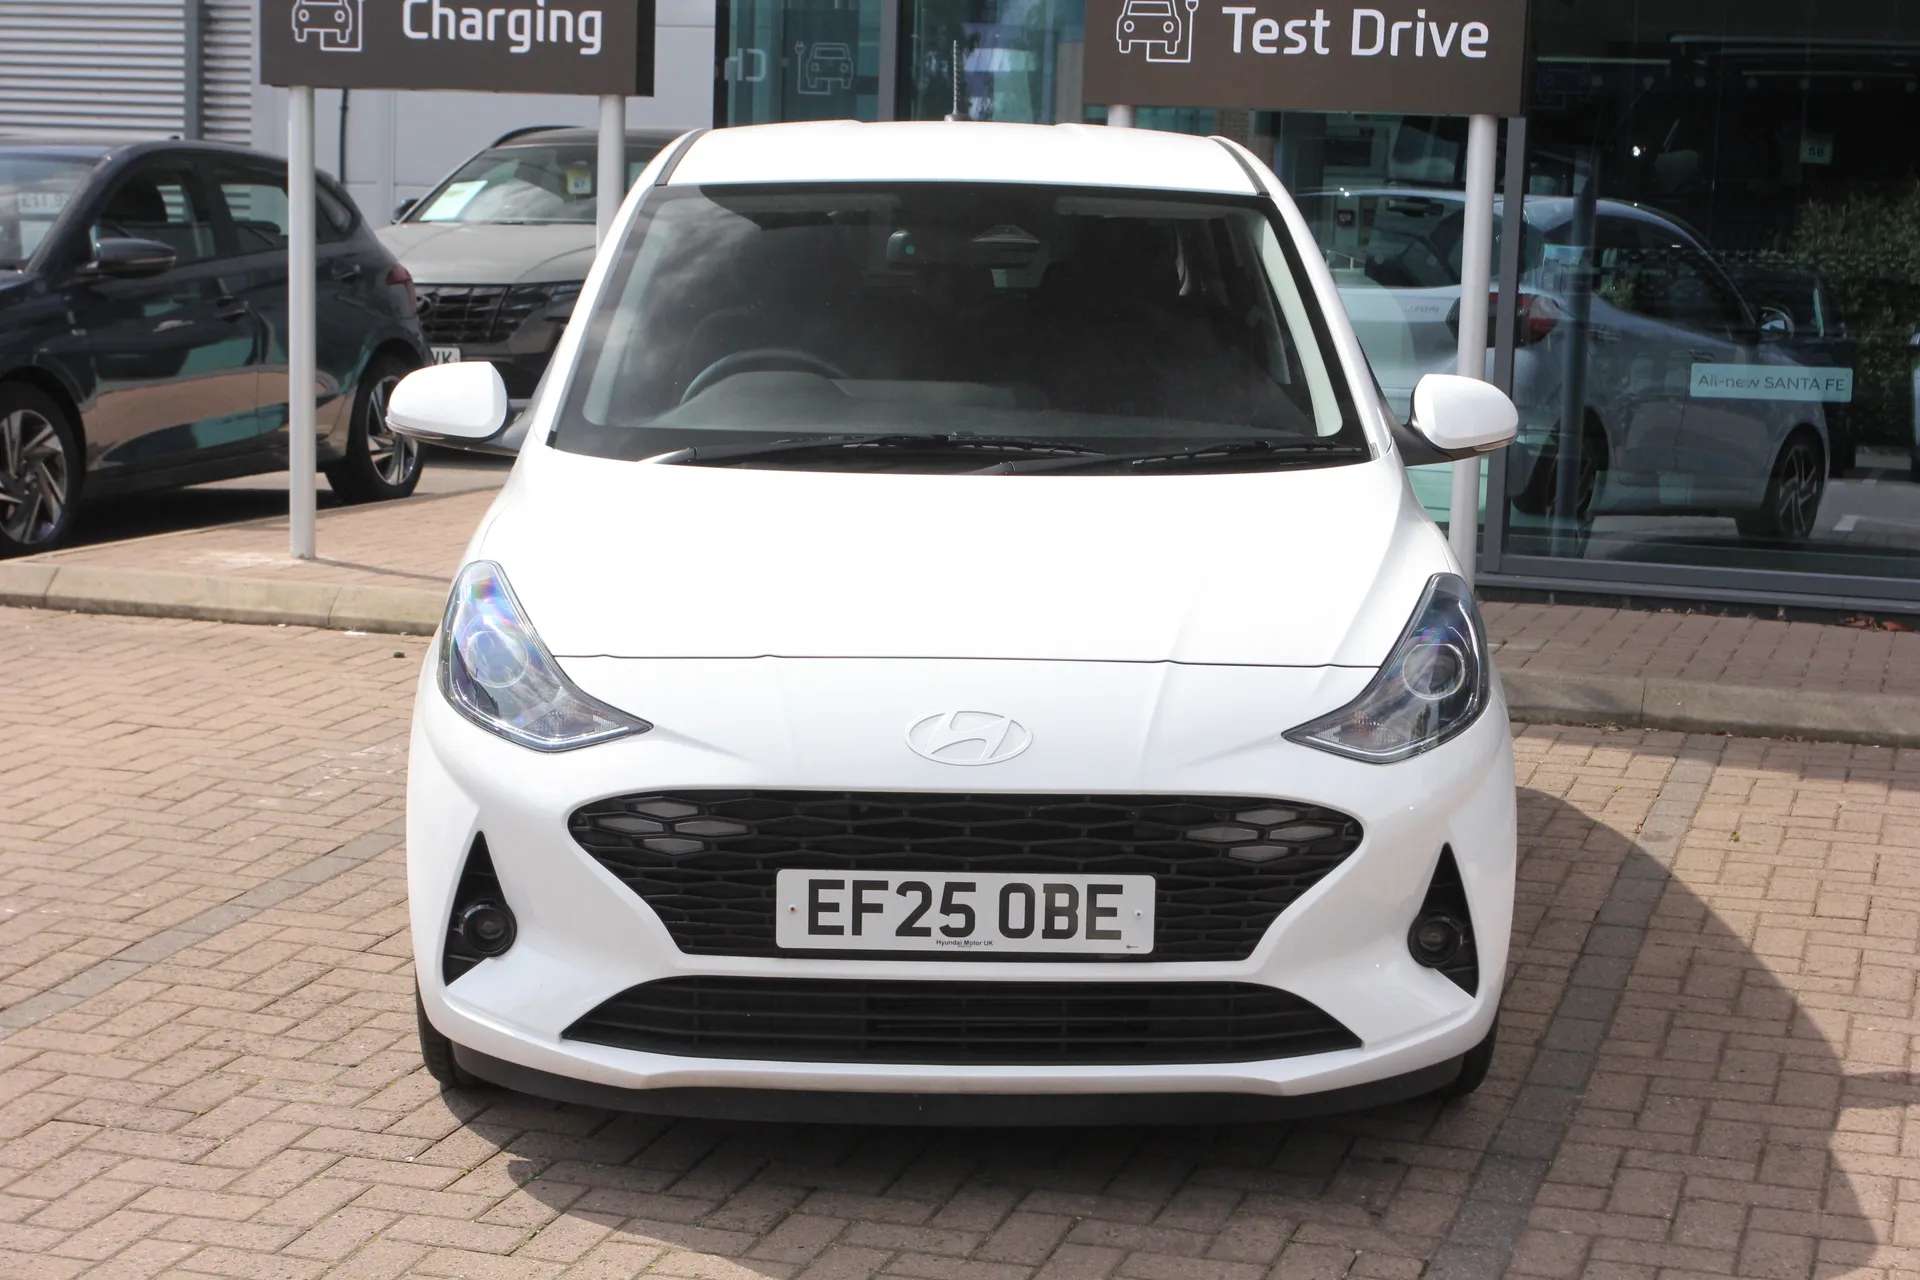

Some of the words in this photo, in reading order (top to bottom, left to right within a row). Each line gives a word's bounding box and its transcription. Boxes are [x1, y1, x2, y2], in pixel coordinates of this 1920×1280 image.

[403, 0, 602, 55] Charging
[1222, 6, 1331, 55] Test
[1352, 8, 1489, 58] Drive
[1698, 375, 1759, 389] All-new
[1764, 377, 1821, 391] SANTA
[1825, 378, 1845, 391] FE
[808, 878, 977, 938] EF25
[998, 882, 1123, 940] OBE
[936, 939, 962, 947] Hyundai
